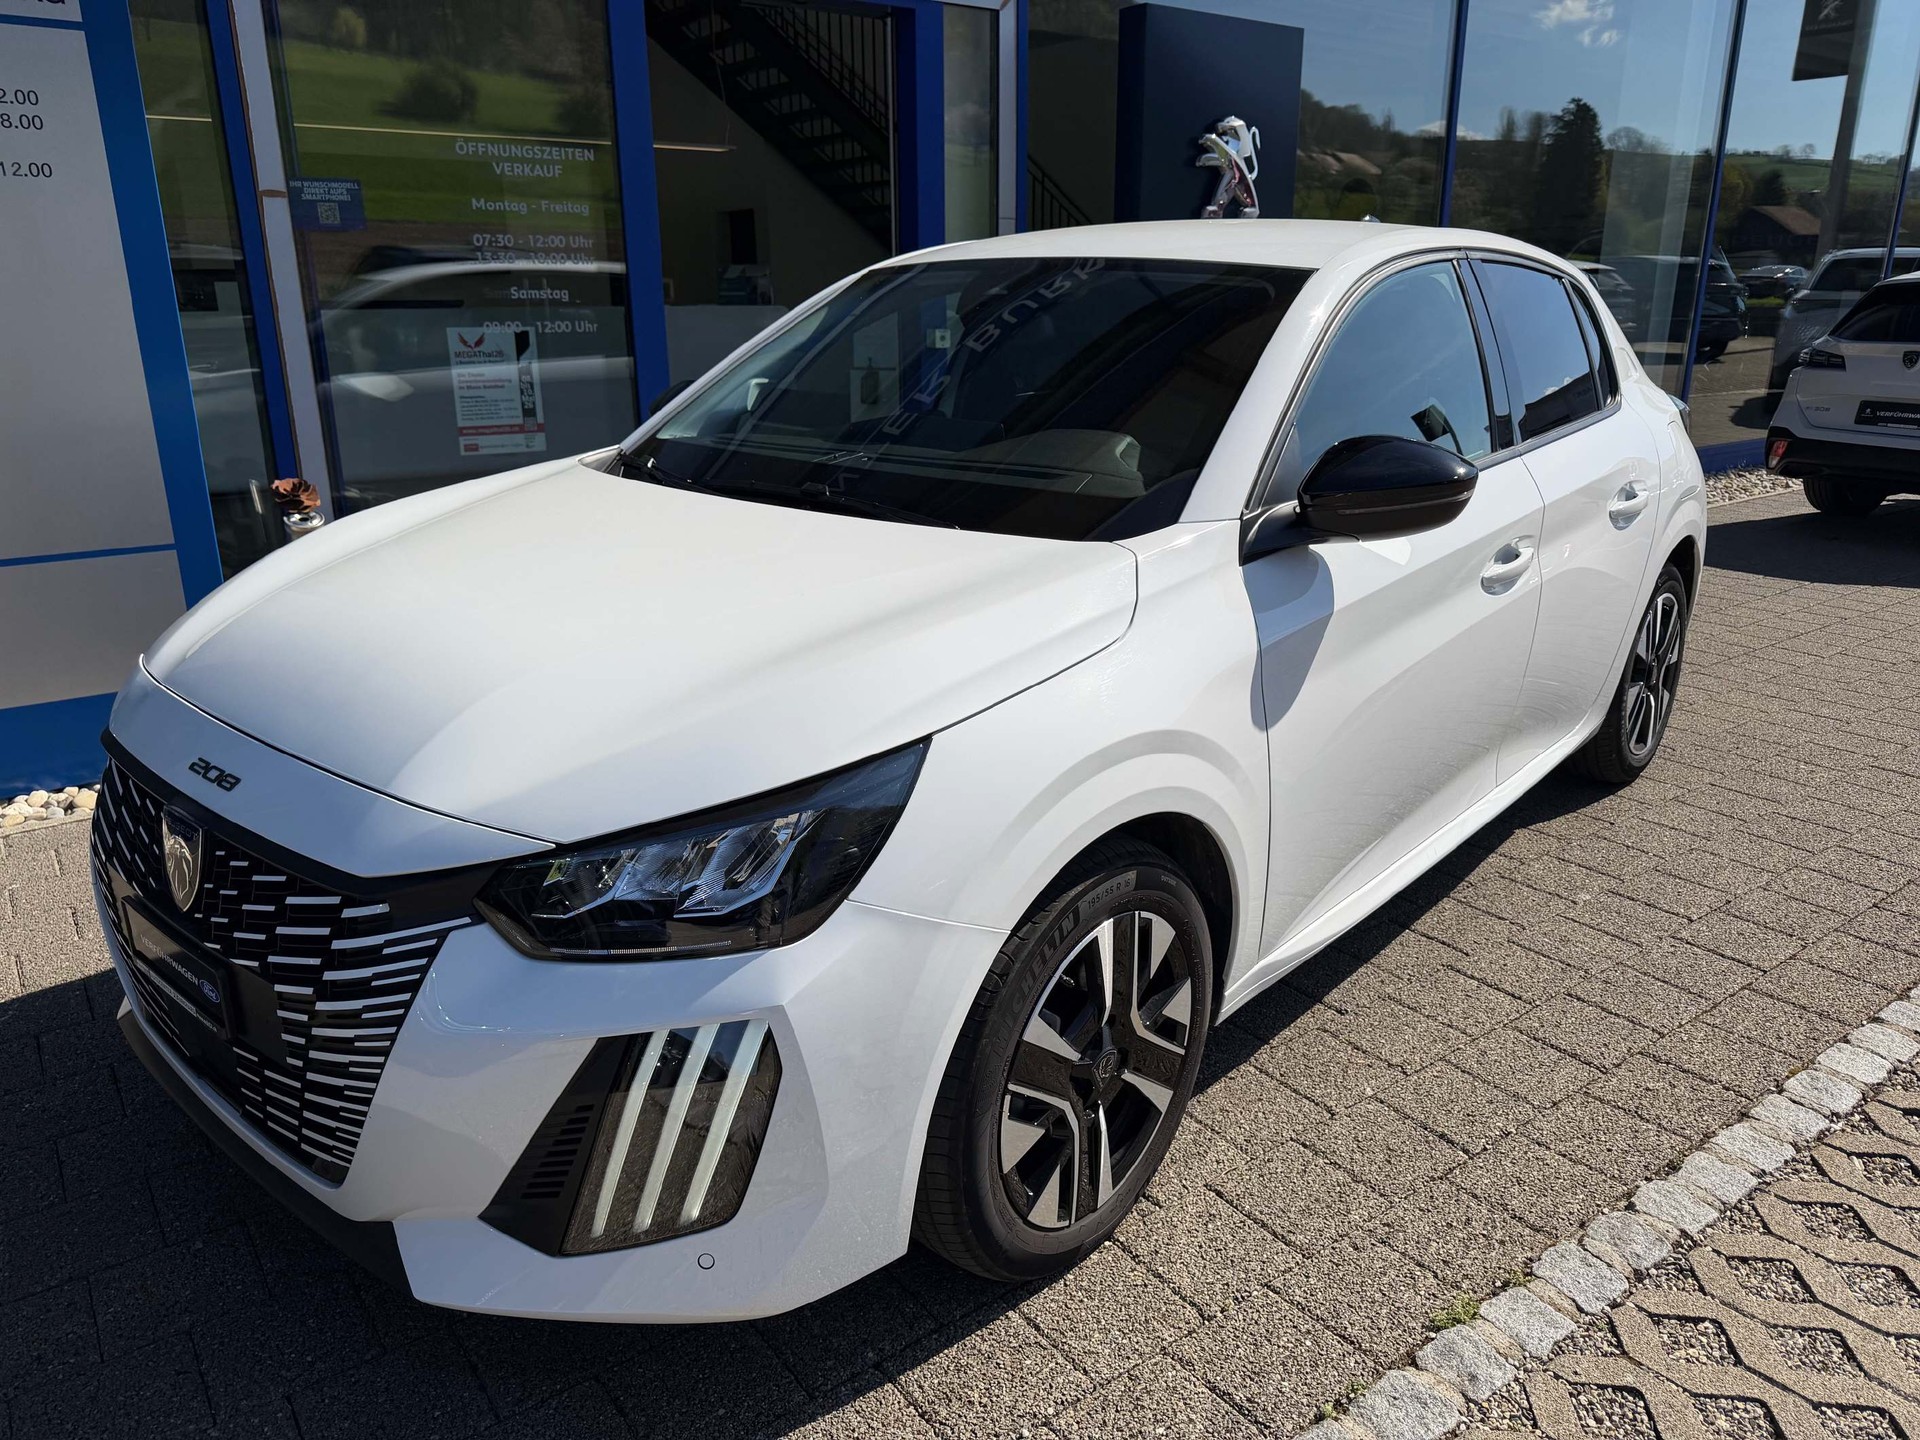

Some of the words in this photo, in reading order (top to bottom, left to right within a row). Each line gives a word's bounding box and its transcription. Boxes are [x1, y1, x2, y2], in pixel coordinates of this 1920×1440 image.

[0, 113, 43, 130] 8.00
[455, 138, 595, 161] ÖFFNUNGSZEITEN
[492, 162, 563, 177] VERKAUF
[289, 180, 302, 188] IHR
[471, 198, 528, 214] Montag
[541, 200, 590, 216] Freitag
[472, 234, 514, 247] 07:30
[528, 234, 566, 248] 12:00
[570, 235, 594, 249] Uhr
[476, 252, 516, 265] 13:30
[571, 253, 595, 266] Uhr
[510, 286, 569, 303] Samstag
[483, 321, 522, 334] 09:00
[535, 321, 573, 334] 12:00
[575, 320, 598, 334] Uhr
[188, 757, 242, 792] 208
[1086, 885, 1114, 909] 195/55
[1116, 882, 1122, 892] R
